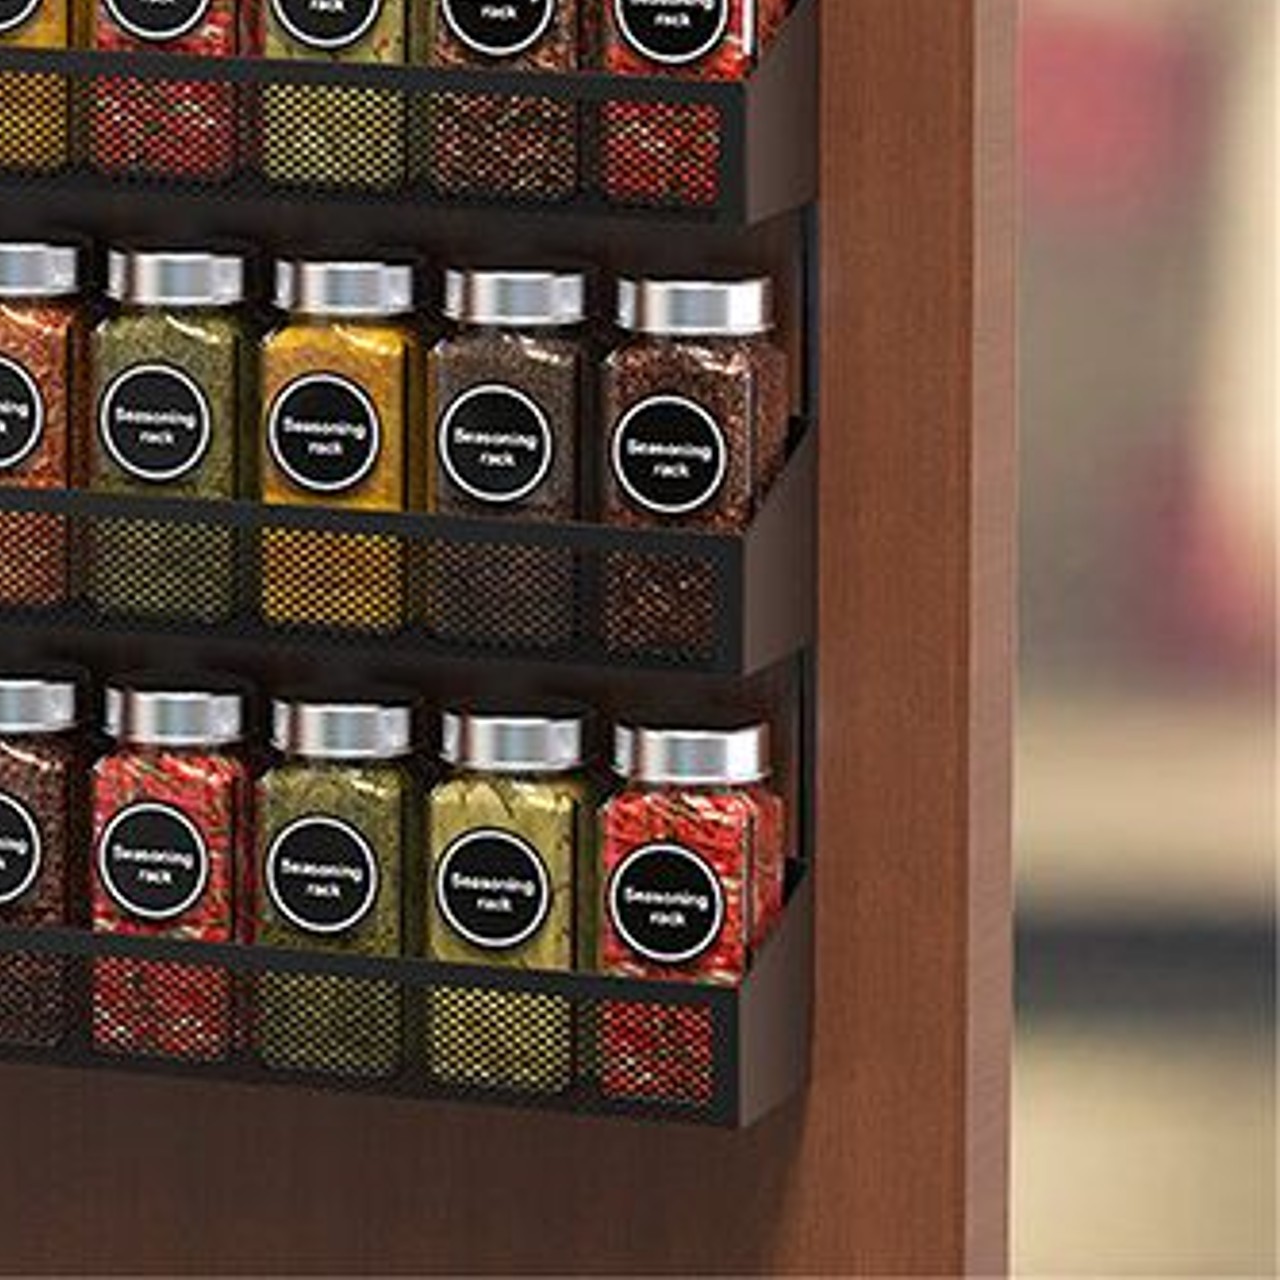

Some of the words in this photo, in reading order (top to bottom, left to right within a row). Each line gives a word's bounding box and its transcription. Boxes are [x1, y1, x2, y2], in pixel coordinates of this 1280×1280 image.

[481, 5, 517, 19] rack
[654, 12, 690, 26] rack
[115, 406, 197, 430] Seasoning
[282, 416, 367, 440] Seasoning
[139, 431, 174, 444] rack
[453, 427, 538, 451] Seasoning
[308, 441, 343, 455] rack
[627, 438, 713, 462] Seasoning
[479, 452, 516, 467] rack
[653, 463, 689, 478] rack
[112, 844, 194, 870] Seasoning
[138, 869, 172, 884] rack
[281, 858, 363, 883] Seasoning
[306, 883, 341, 897] rack
[451, 872, 536, 897] Seasoning
[476, 897, 512, 912] rack
[624, 886, 709, 912] Seasoning
[649, 912, 685, 926] rack
